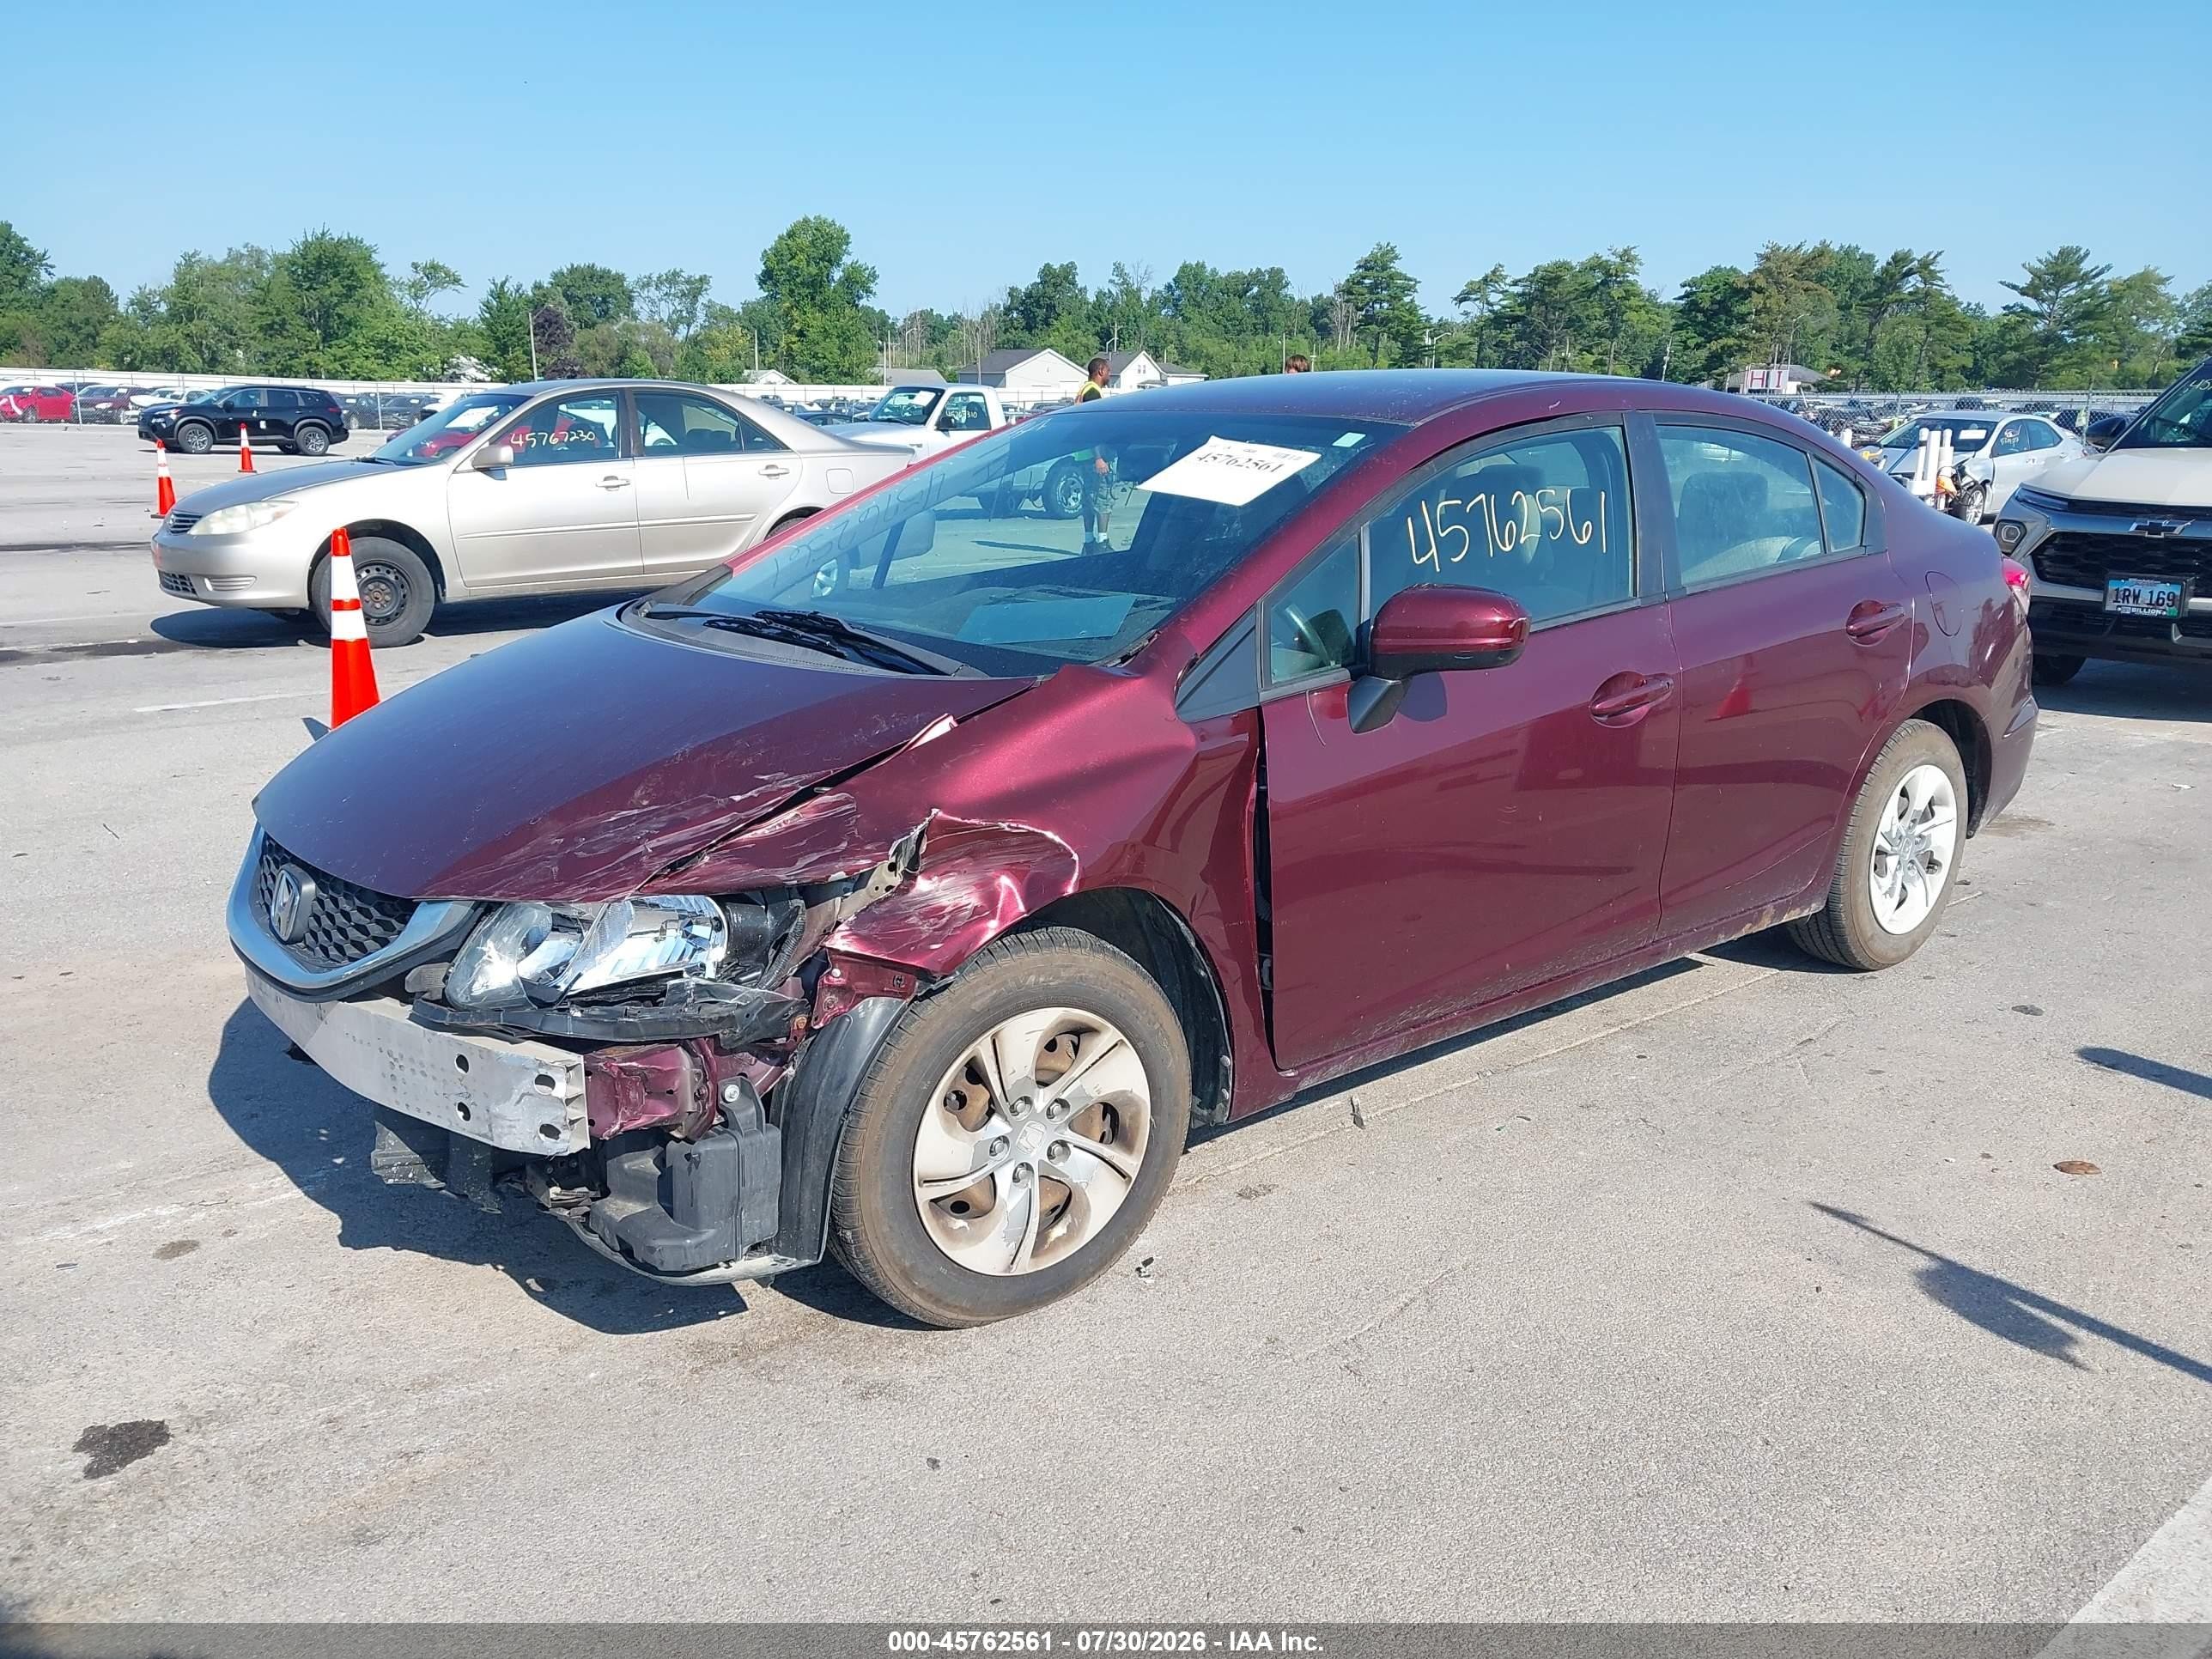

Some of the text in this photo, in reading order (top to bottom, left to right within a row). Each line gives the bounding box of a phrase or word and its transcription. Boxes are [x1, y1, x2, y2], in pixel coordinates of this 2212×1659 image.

[510, 429, 596, 448] 45767230
[1197, 453, 1285, 473] 45762561
[1407, 488, 1607, 573] 45762561
[2144, 590, 2176, 608] 169
